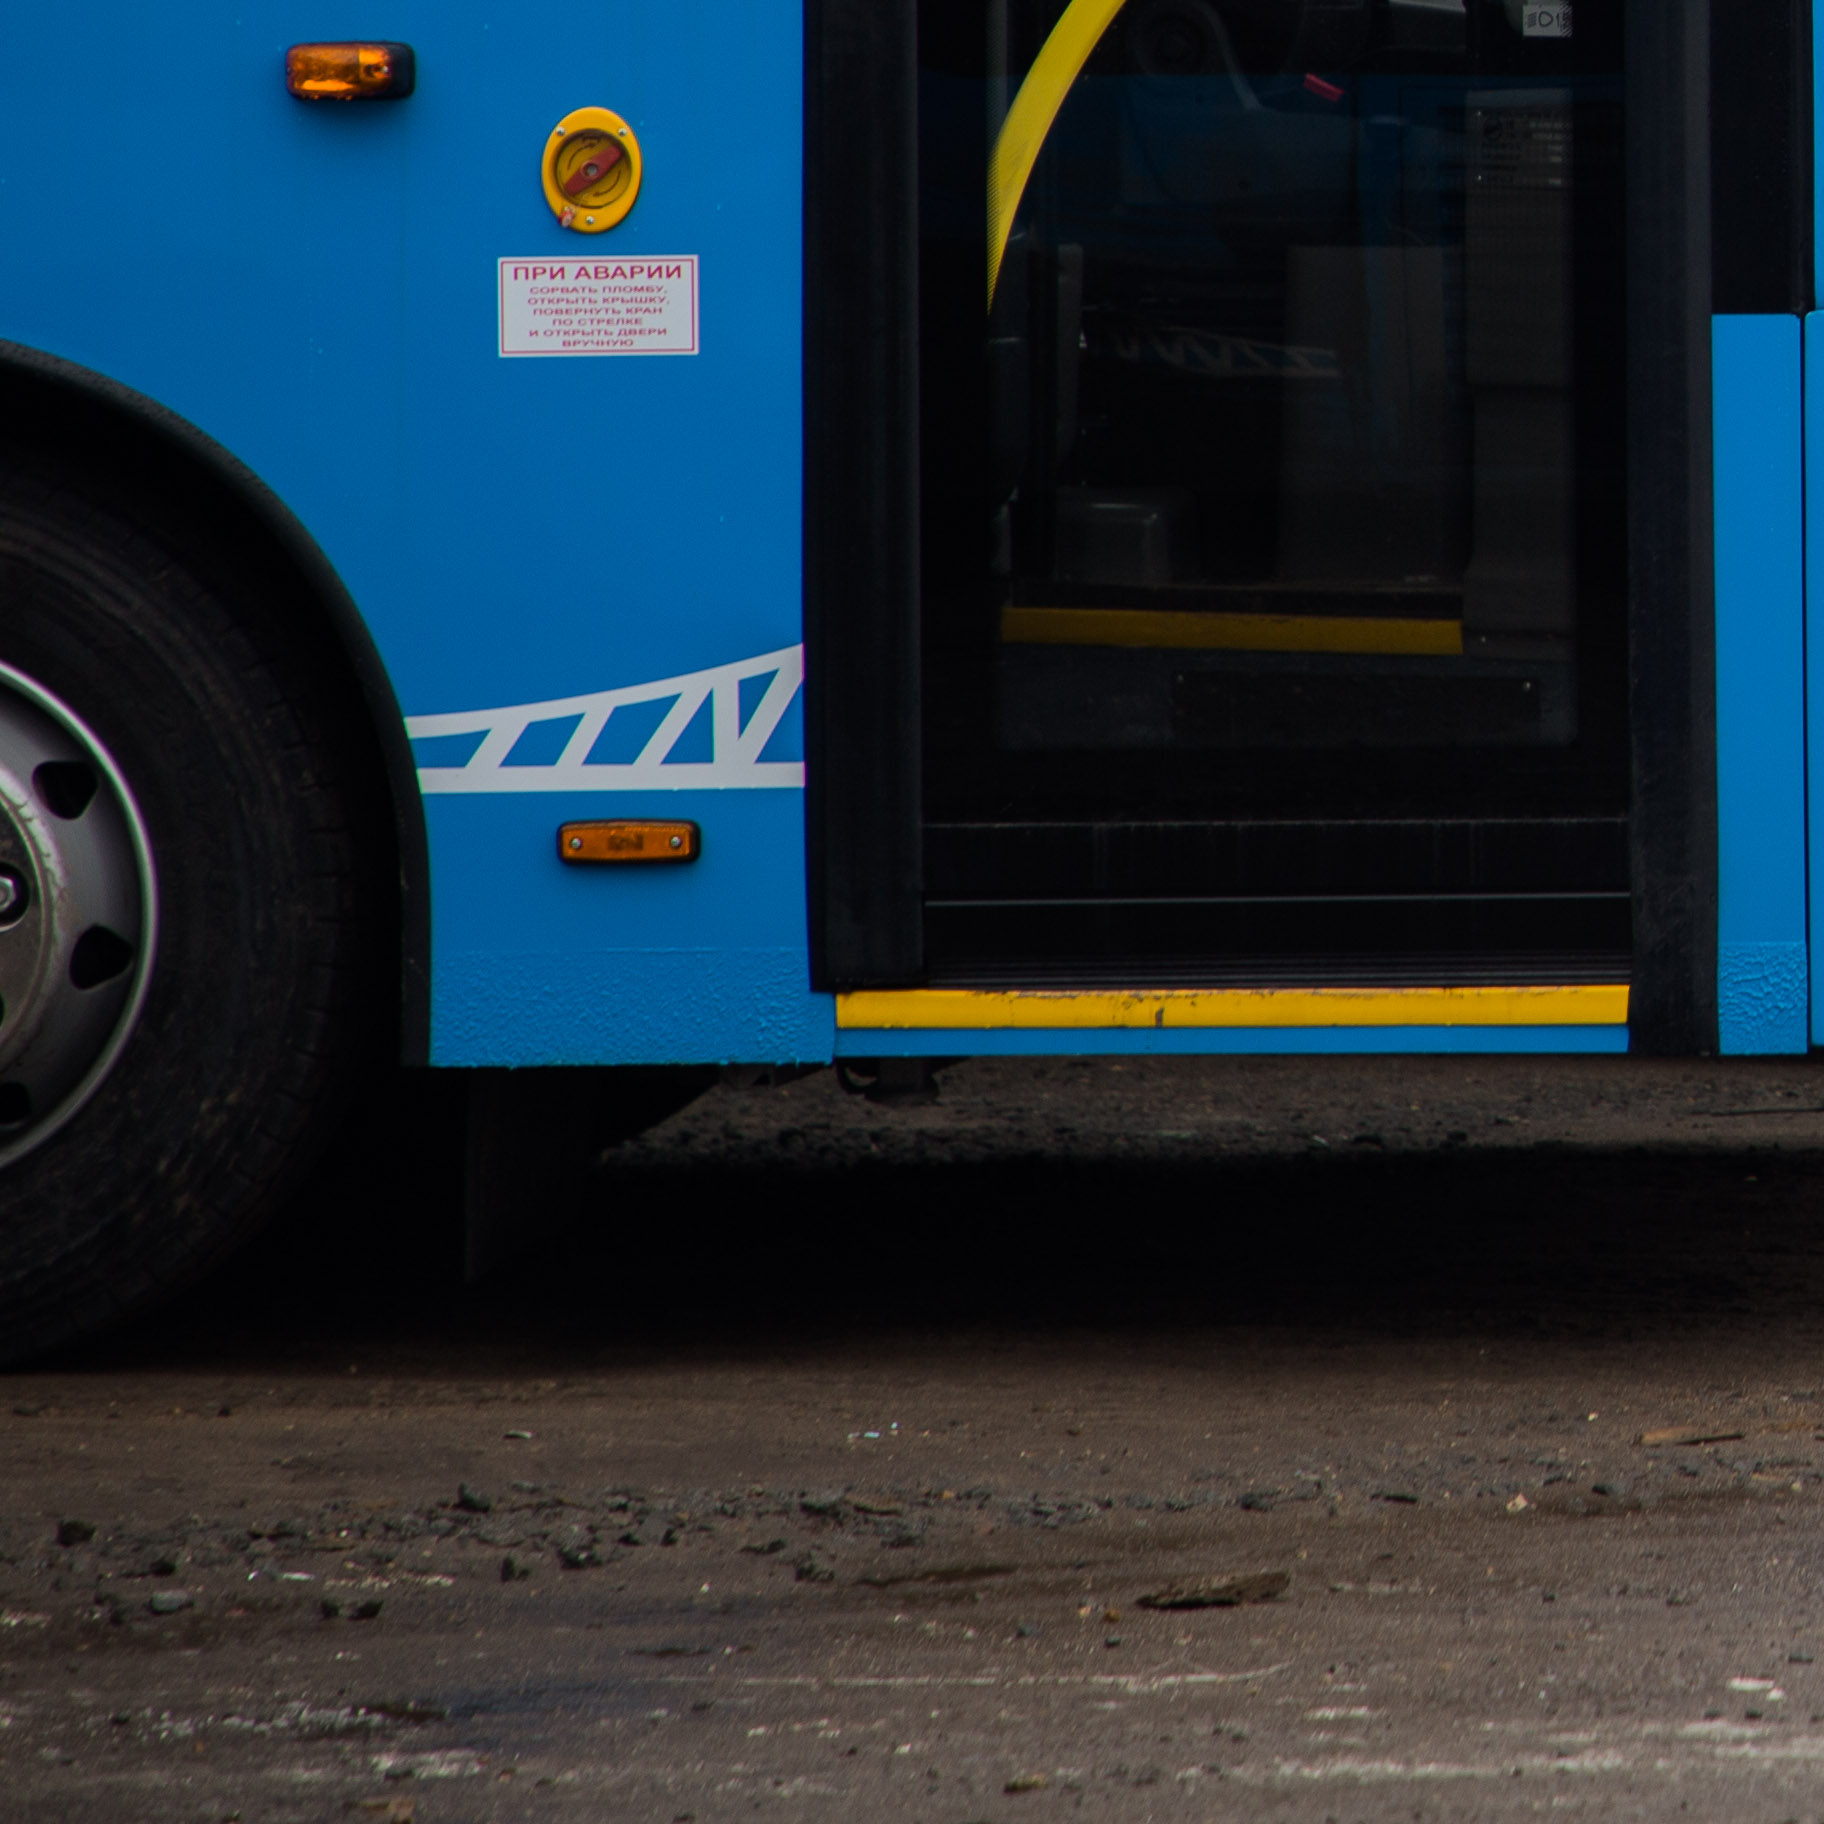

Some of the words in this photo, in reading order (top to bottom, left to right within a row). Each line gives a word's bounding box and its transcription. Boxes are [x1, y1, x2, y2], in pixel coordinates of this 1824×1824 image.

[513, 266, 565, 281] ПРИ
[574, 264, 681, 280] АВАРИИ
[529, 286, 598, 295] СОРВАТЬ
[527, 297, 598, 306] ОТКРЫТЬ
[533, 307, 622, 316] ПОВЕРНУТЬ
[552, 318, 574, 326] ПО
[577, 317, 643, 326] СТРЕЛКЕ
[529, 329, 539, 337] И
[543, 328, 613, 337] ОТКРЫТЬ
[617, 327, 668, 337] ДВЕРИ
[562, 338, 634, 348] ВРУЧНУЮ
